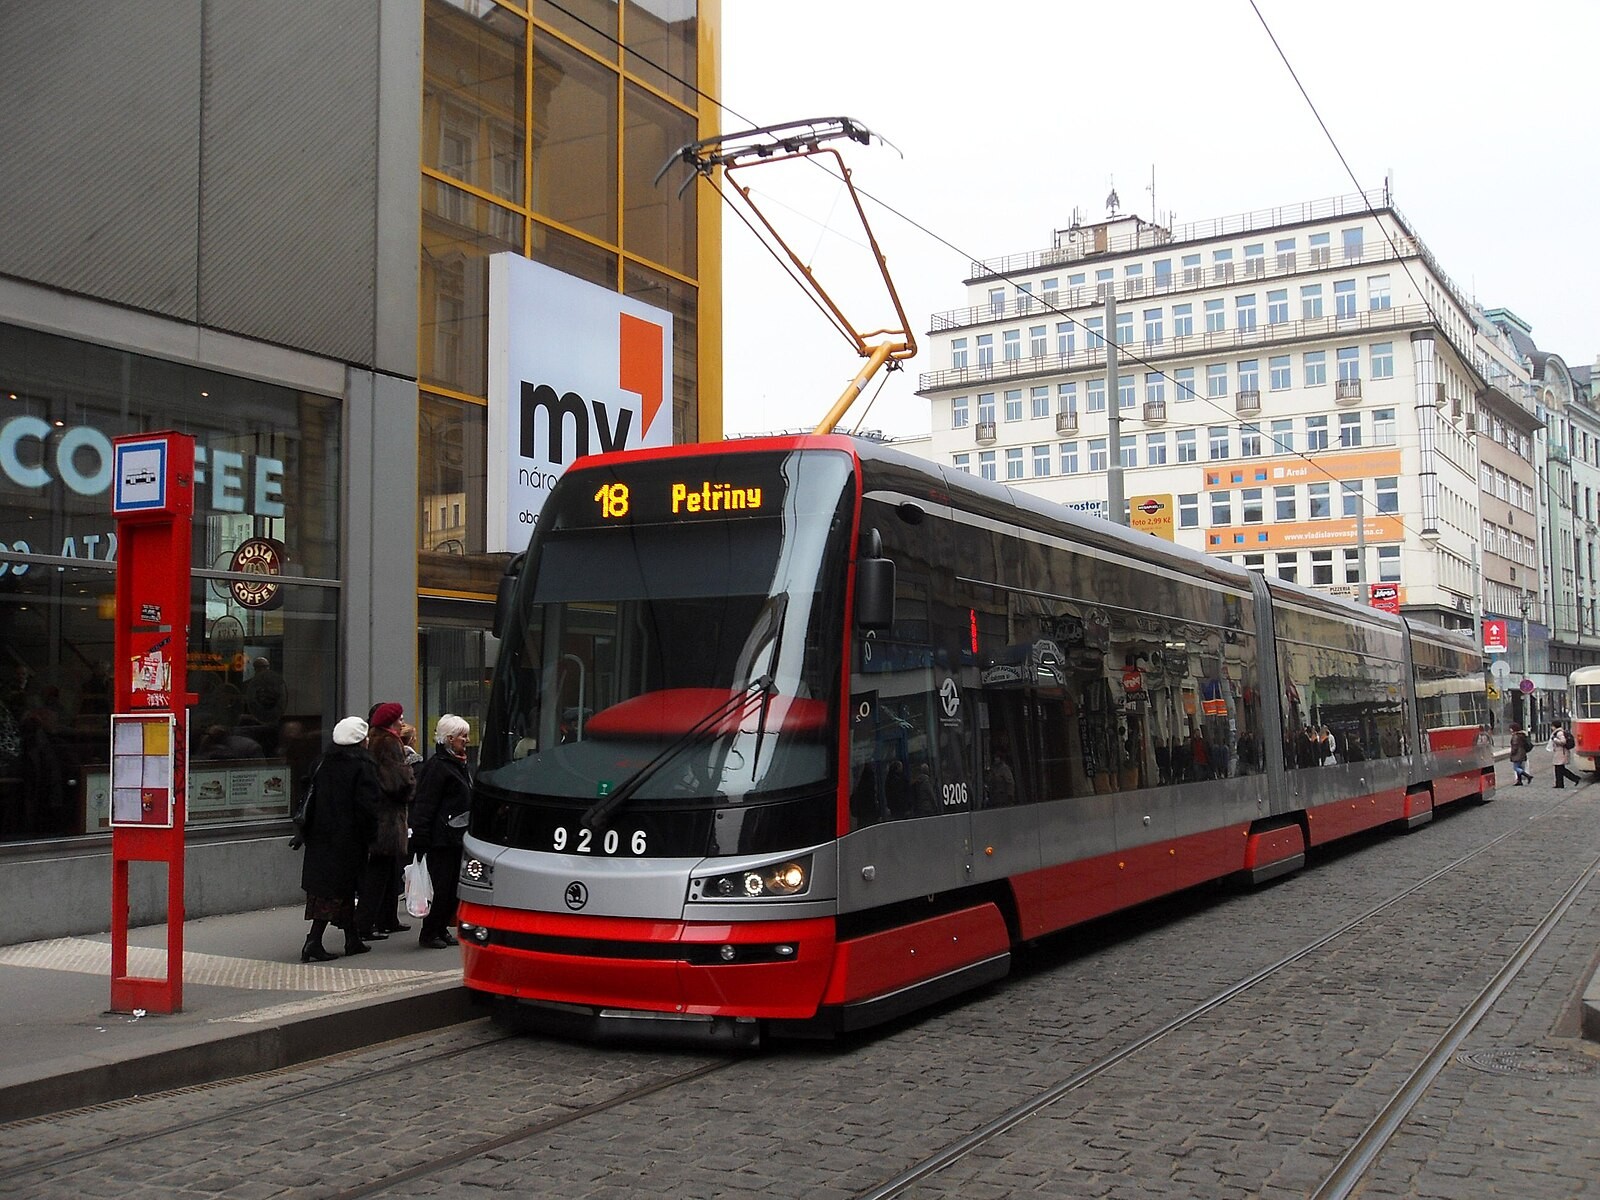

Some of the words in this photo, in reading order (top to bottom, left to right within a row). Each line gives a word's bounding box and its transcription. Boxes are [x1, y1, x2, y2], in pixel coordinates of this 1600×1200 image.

[0, 415, 285, 518] COEE
[1286, 467, 1308, 477] Areál
[594, 483, 629, 518] 18
[672, 481, 762, 513] Petřiny
[1132, 518, 1146, 526] foto
[1147, 517, 1162, 526] 2,99
[1284, 528, 1384, 541] www.vladislavovaspana.cz
[238, 544, 273, 565] COSTA
[235, 582, 276, 604] COFFEE
[942, 782, 968, 806] 9206
[553, 827, 647, 855] 9206
